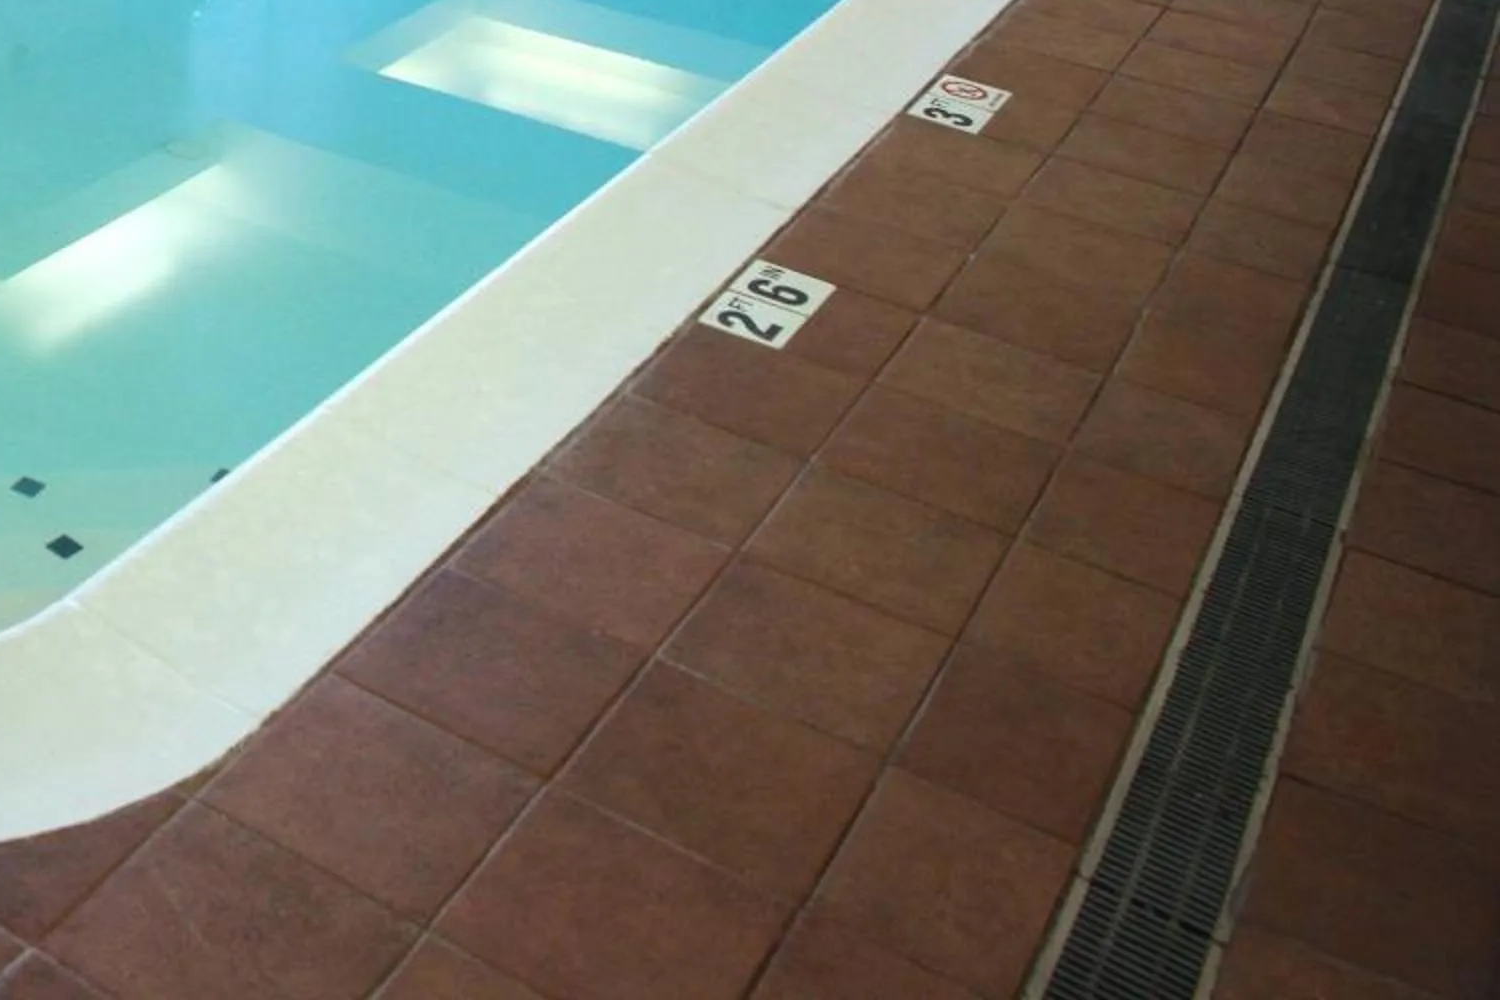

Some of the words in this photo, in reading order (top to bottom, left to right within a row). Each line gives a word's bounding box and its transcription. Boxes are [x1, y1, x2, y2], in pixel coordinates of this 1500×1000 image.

[923, 107, 973, 127] 3
[747, 279, 809, 306] 6
[728, 297, 753, 312] FT
[717, 310, 784, 342] 2
